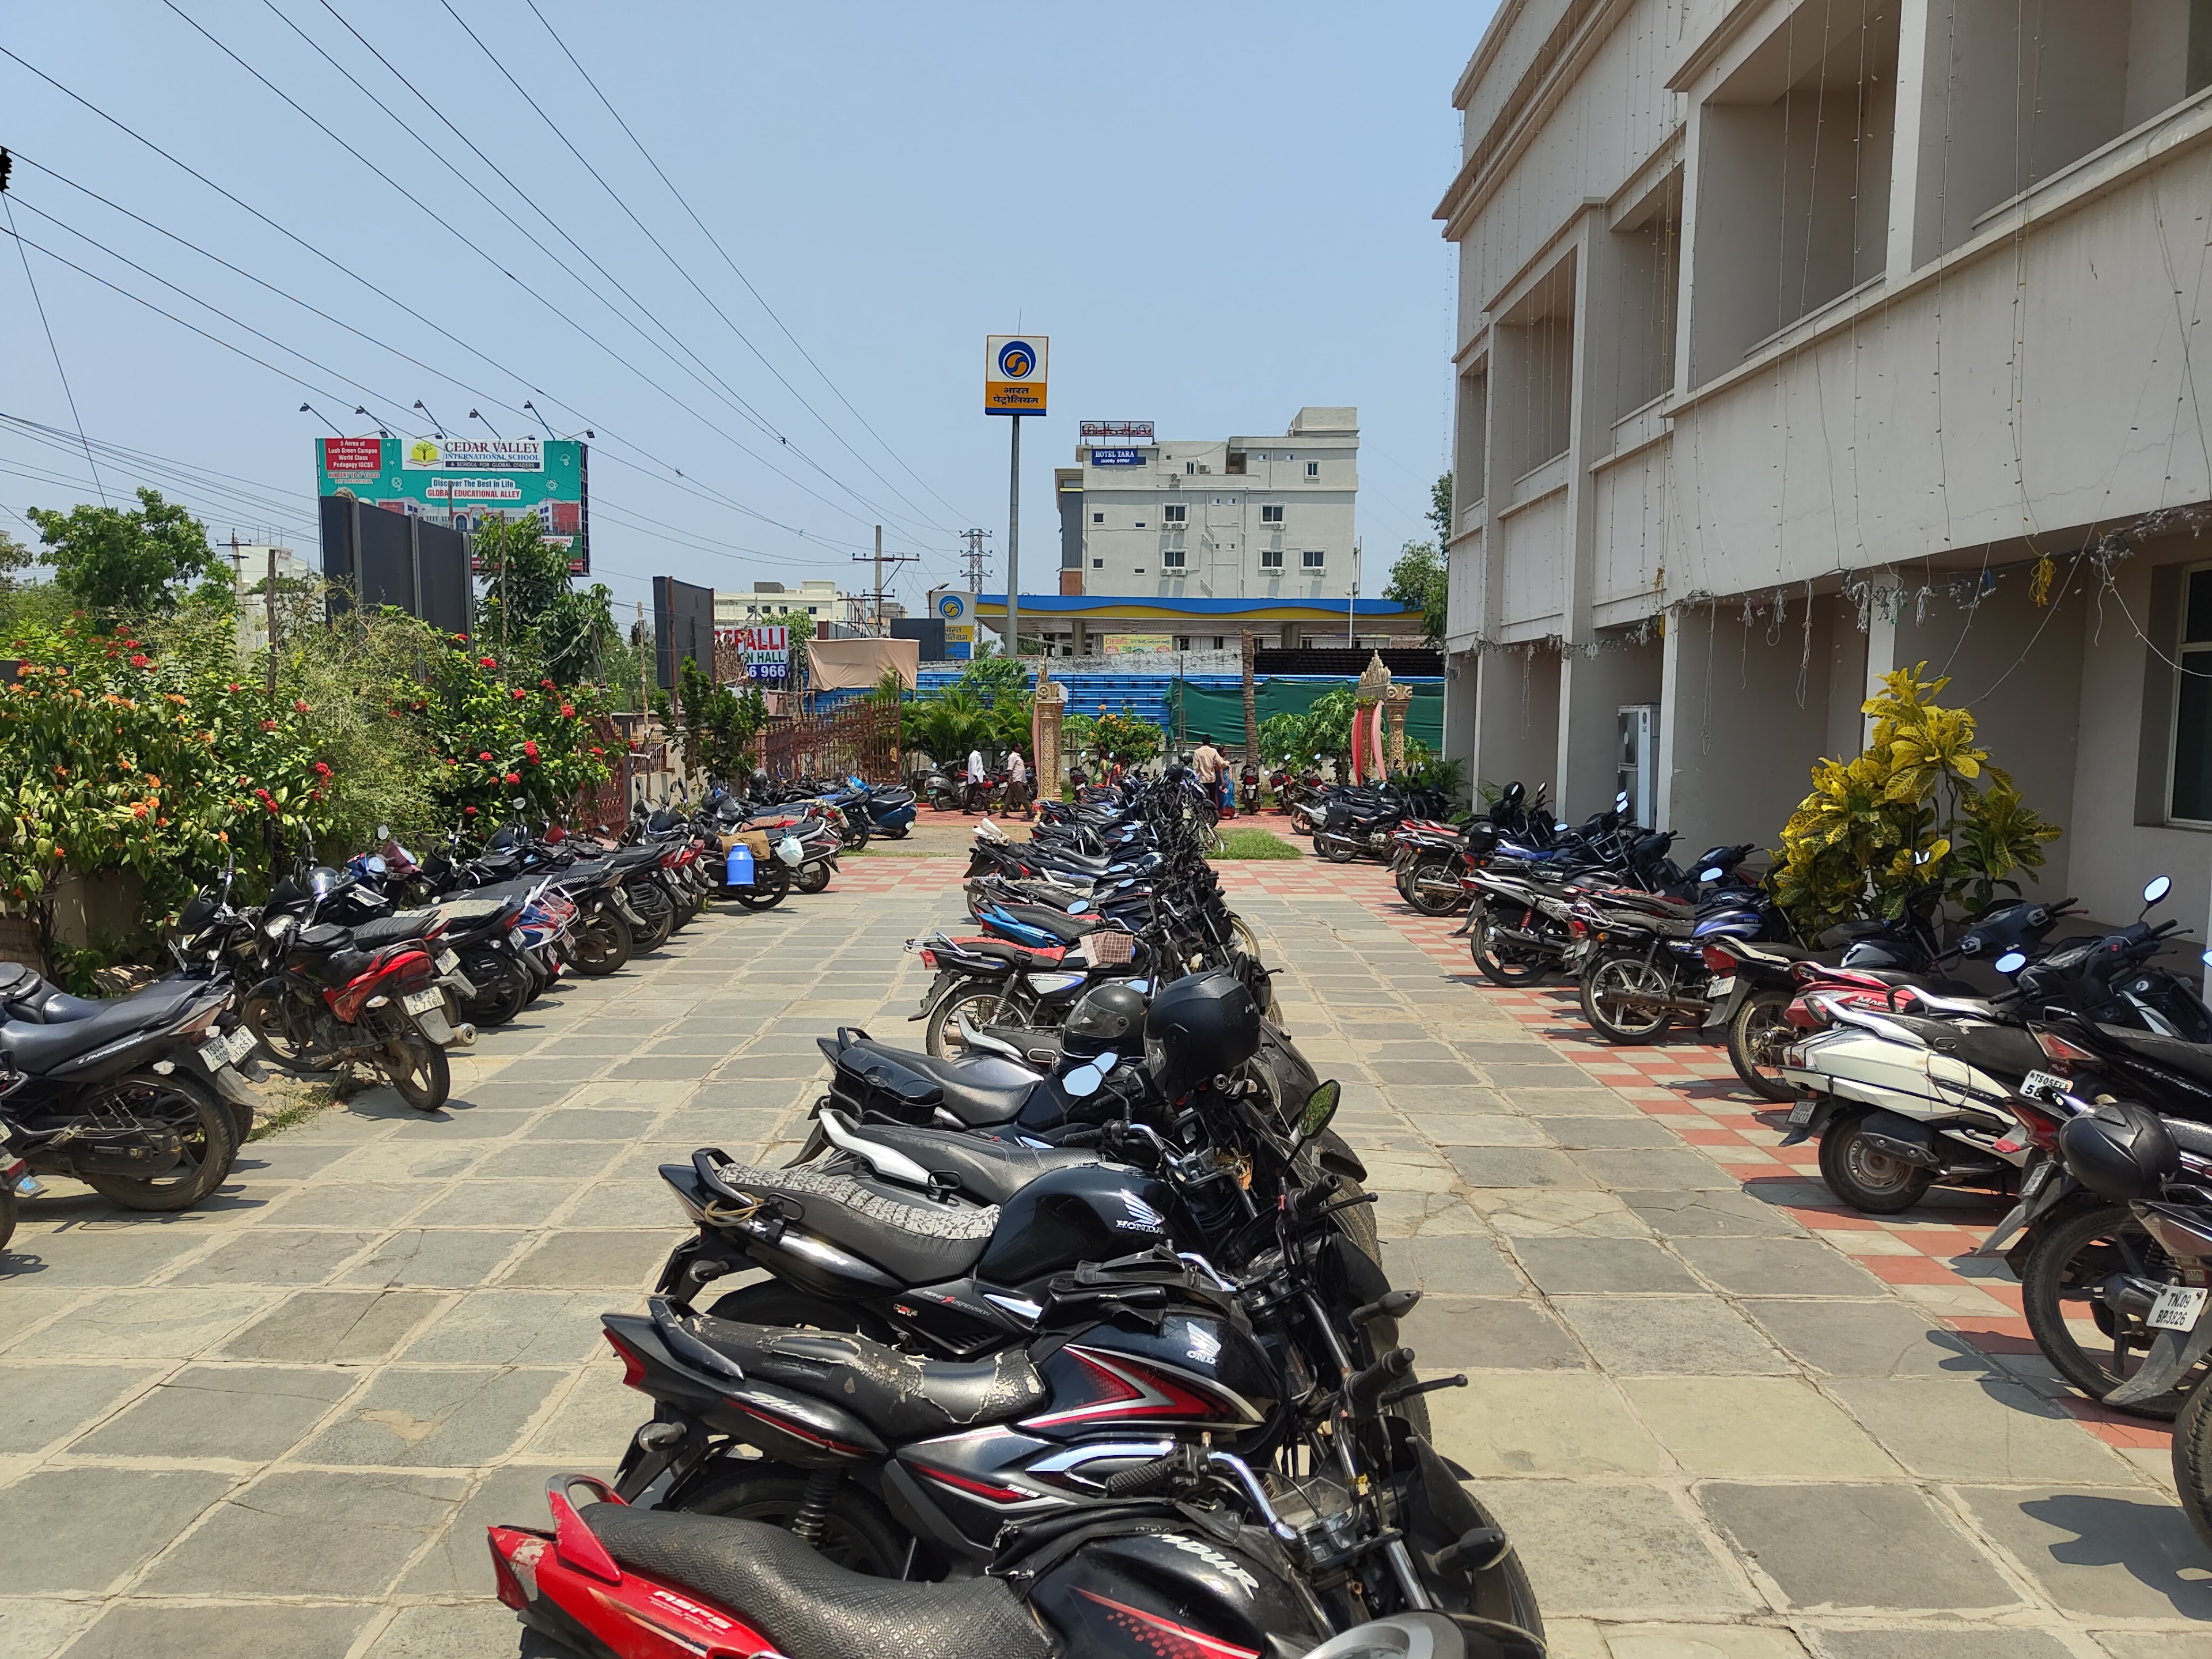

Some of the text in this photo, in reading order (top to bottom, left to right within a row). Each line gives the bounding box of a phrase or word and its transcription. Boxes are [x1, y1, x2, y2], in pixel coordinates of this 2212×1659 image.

[993, 393, 1039, 406] पेट्रोलियम
[445, 442, 540, 453] CEDAR VALLEY
[433, 479, 462, 487] Discver
[477, 480, 492, 488] Best
[500, 490, 520, 498] ALLEY
[757, 652, 785, 664] HALL
[760, 665, 786, 677] 966
[411, 994, 423, 1003] TS
[414, 1004, 420, 1012] C
[1116, 1219, 1166, 1234] HONDA
[653, 1590, 733, 1630] ASFS
